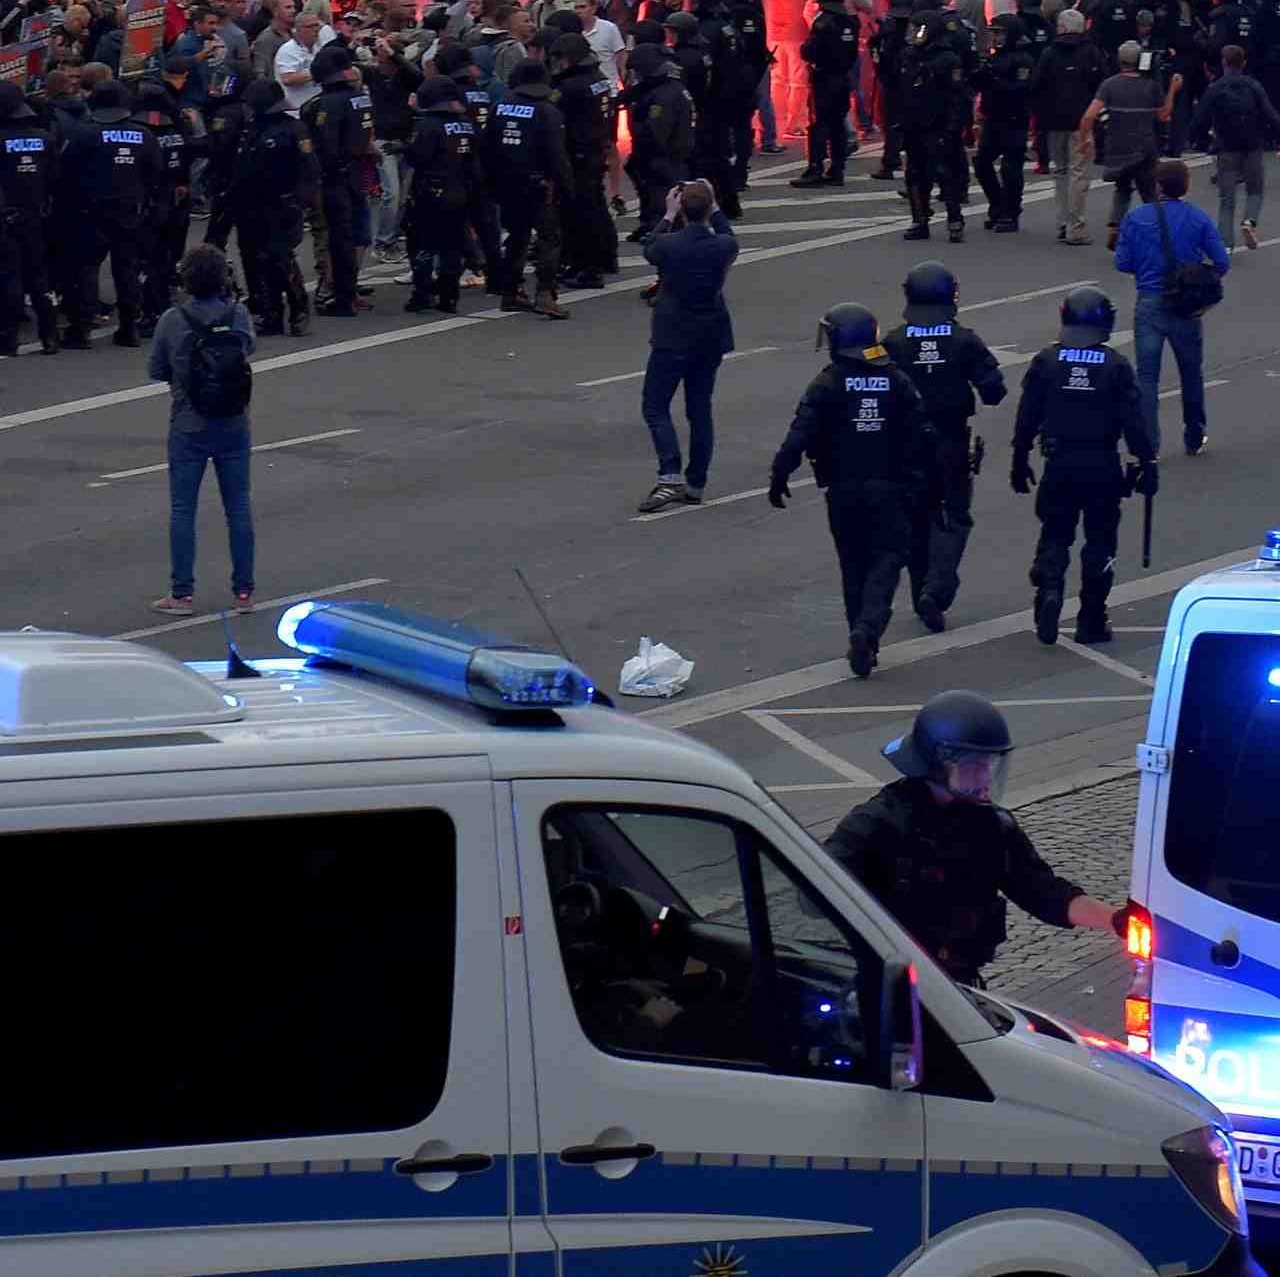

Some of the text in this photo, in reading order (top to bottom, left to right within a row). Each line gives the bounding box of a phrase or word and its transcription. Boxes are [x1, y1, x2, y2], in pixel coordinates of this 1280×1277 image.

[496, 103, 535, 119] POLIZEI
[102, 129, 144, 145] POLIZEI
[4, 137, 46, 154] POLIZEI
[905, 324, 953, 339] POLIZEI
[1058, 348, 1105, 365] POLIZEI
[845, 377, 891, 392] POLIZEI
[860, 398, 879, 409] SN
